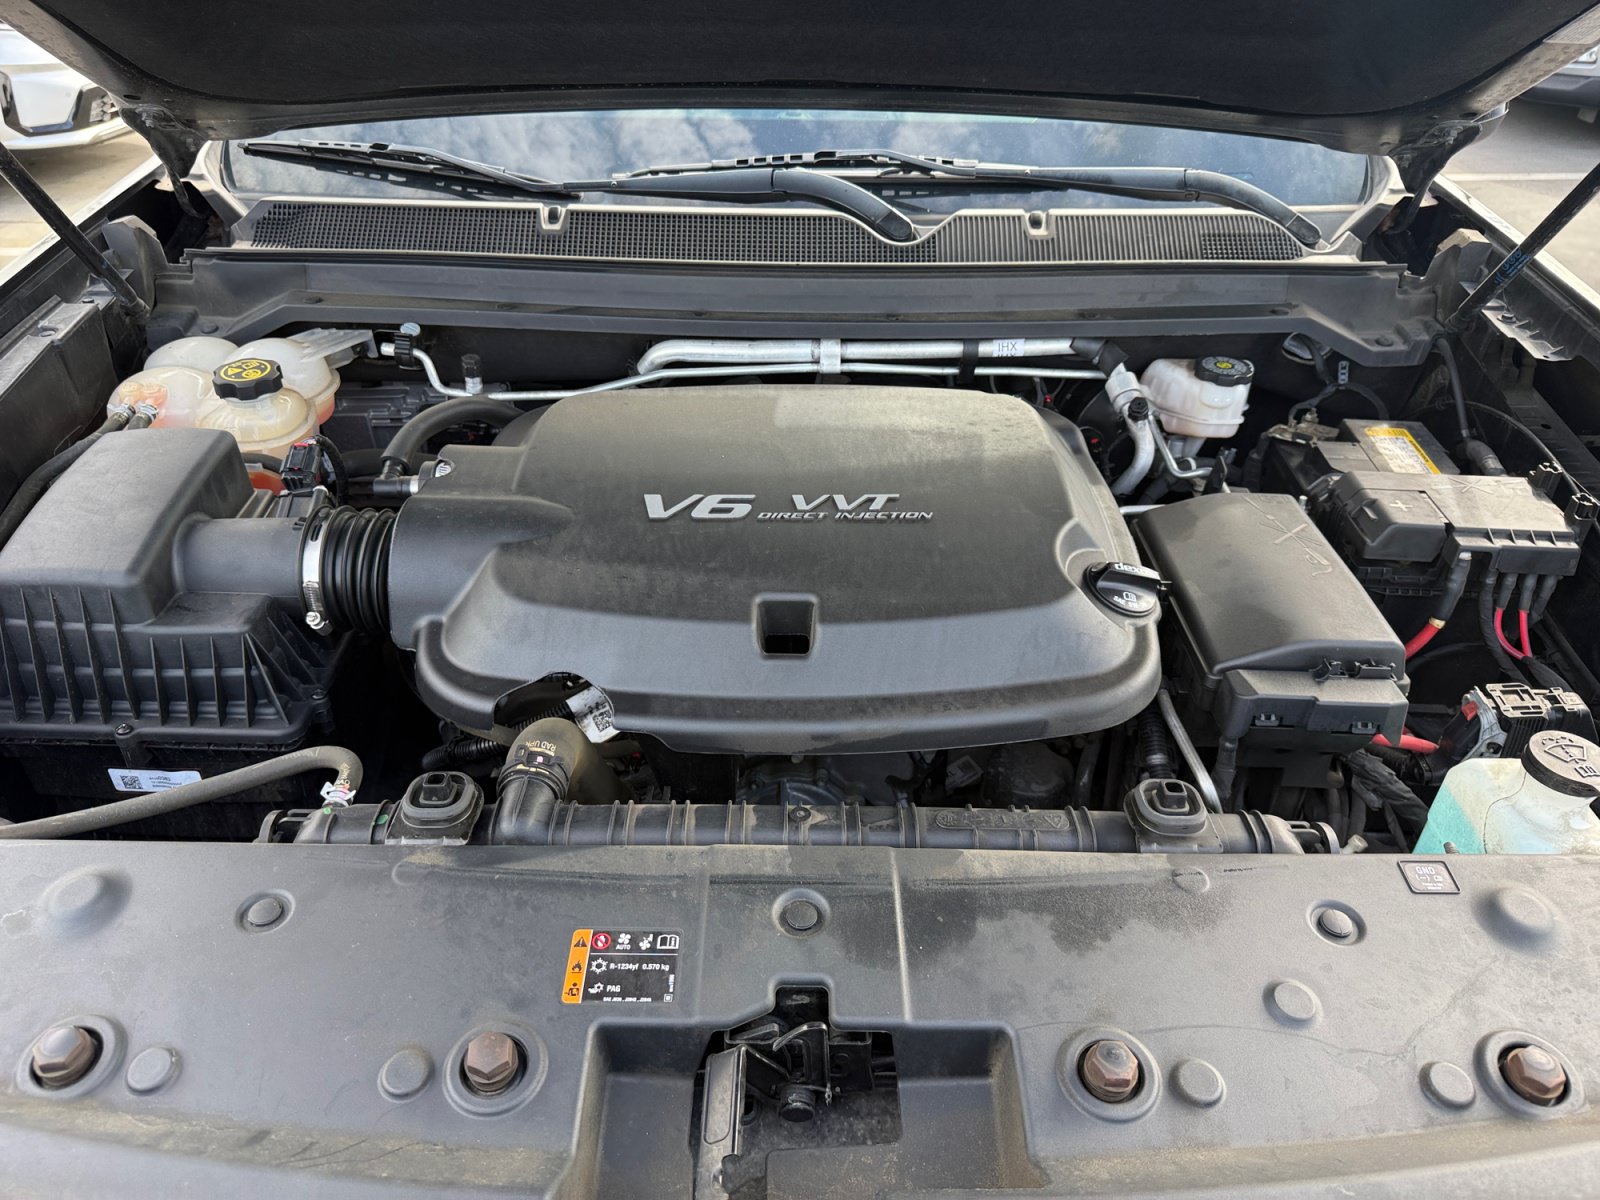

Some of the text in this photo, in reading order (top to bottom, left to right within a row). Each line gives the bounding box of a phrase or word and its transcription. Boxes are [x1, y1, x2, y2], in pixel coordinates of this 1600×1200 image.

[998, 341, 1017, 352] IHX
[643, 494, 756, 519] V6
[791, 494, 900, 511] VVT
[757, 511, 934, 519] DIRECT INJECTION
[541, 741, 556, 751] RAD
[609, 963, 670, 971] R-1234yf 0.570 kg
